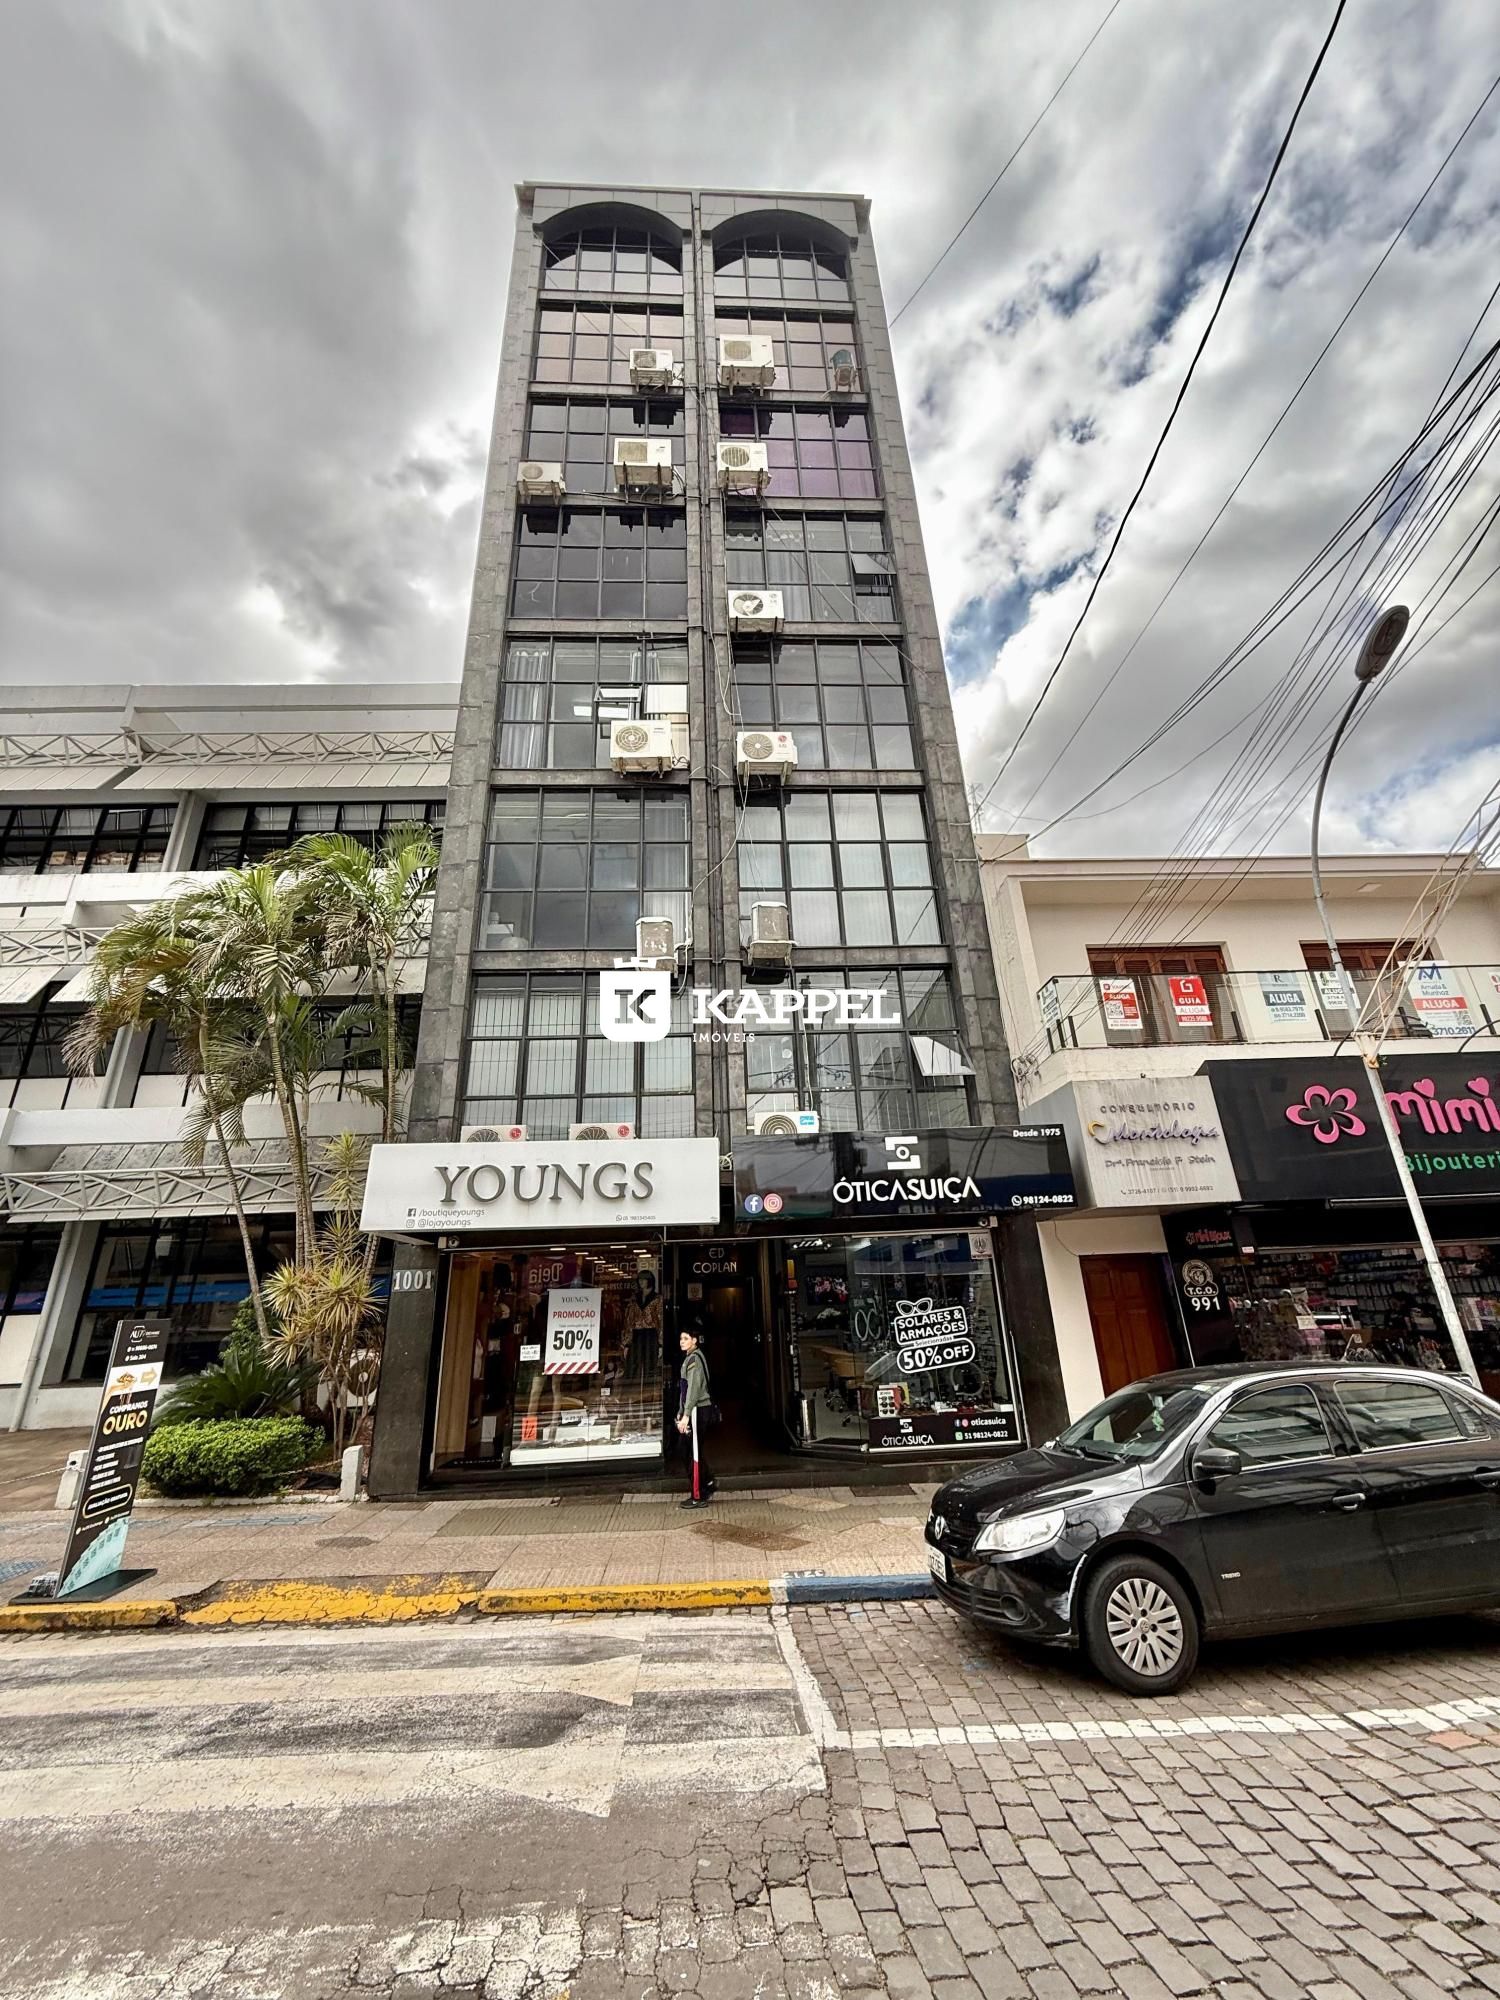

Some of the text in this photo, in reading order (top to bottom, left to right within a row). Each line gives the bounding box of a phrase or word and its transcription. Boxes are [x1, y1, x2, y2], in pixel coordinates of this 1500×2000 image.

[1179, 997, 1201, 1005] GUIA
[1269, 993, 1301, 1004] ALUGA
[1422, 1000, 1459, 1009] ALUGA
[1013, 1128, 1061, 1137] Desde 1975
[435, 1162, 654, 1202] YOUNGS
[833, 1176, 982, 1204] ÓTICASUIÇA
[1023, 1194, 1073, 1204] 98124-0822
[418, 1218, 472, 1228] @lojayoungs
[709, 1247, 725, 1258] ED
[693, 1261, 737, 1273] COPLAN
[394, 1269, 434, 1291] 1001
[1187, 1287, 1216, 1295] T.C.O.
[1191, 1297, 1220, 1311] 991
[553, 1309, 596, 1320] PROMOÇÃO
[898, 1309, 962, 1329] SOLARES &
[900, 1321, 965, 1341] ARMAÇÕES
[553, 1330, 593, 1350] 50%
[903, 1345, 969, 1369] 50% OFF
[109, 1400, 148, 1414] COMPRAMOS
[103, 1410, 147, 1435] OURO
[882, 1434, 934, 1446] ÓTICASUIÇA
[1220, 1572, 1241, 1580] TREND
